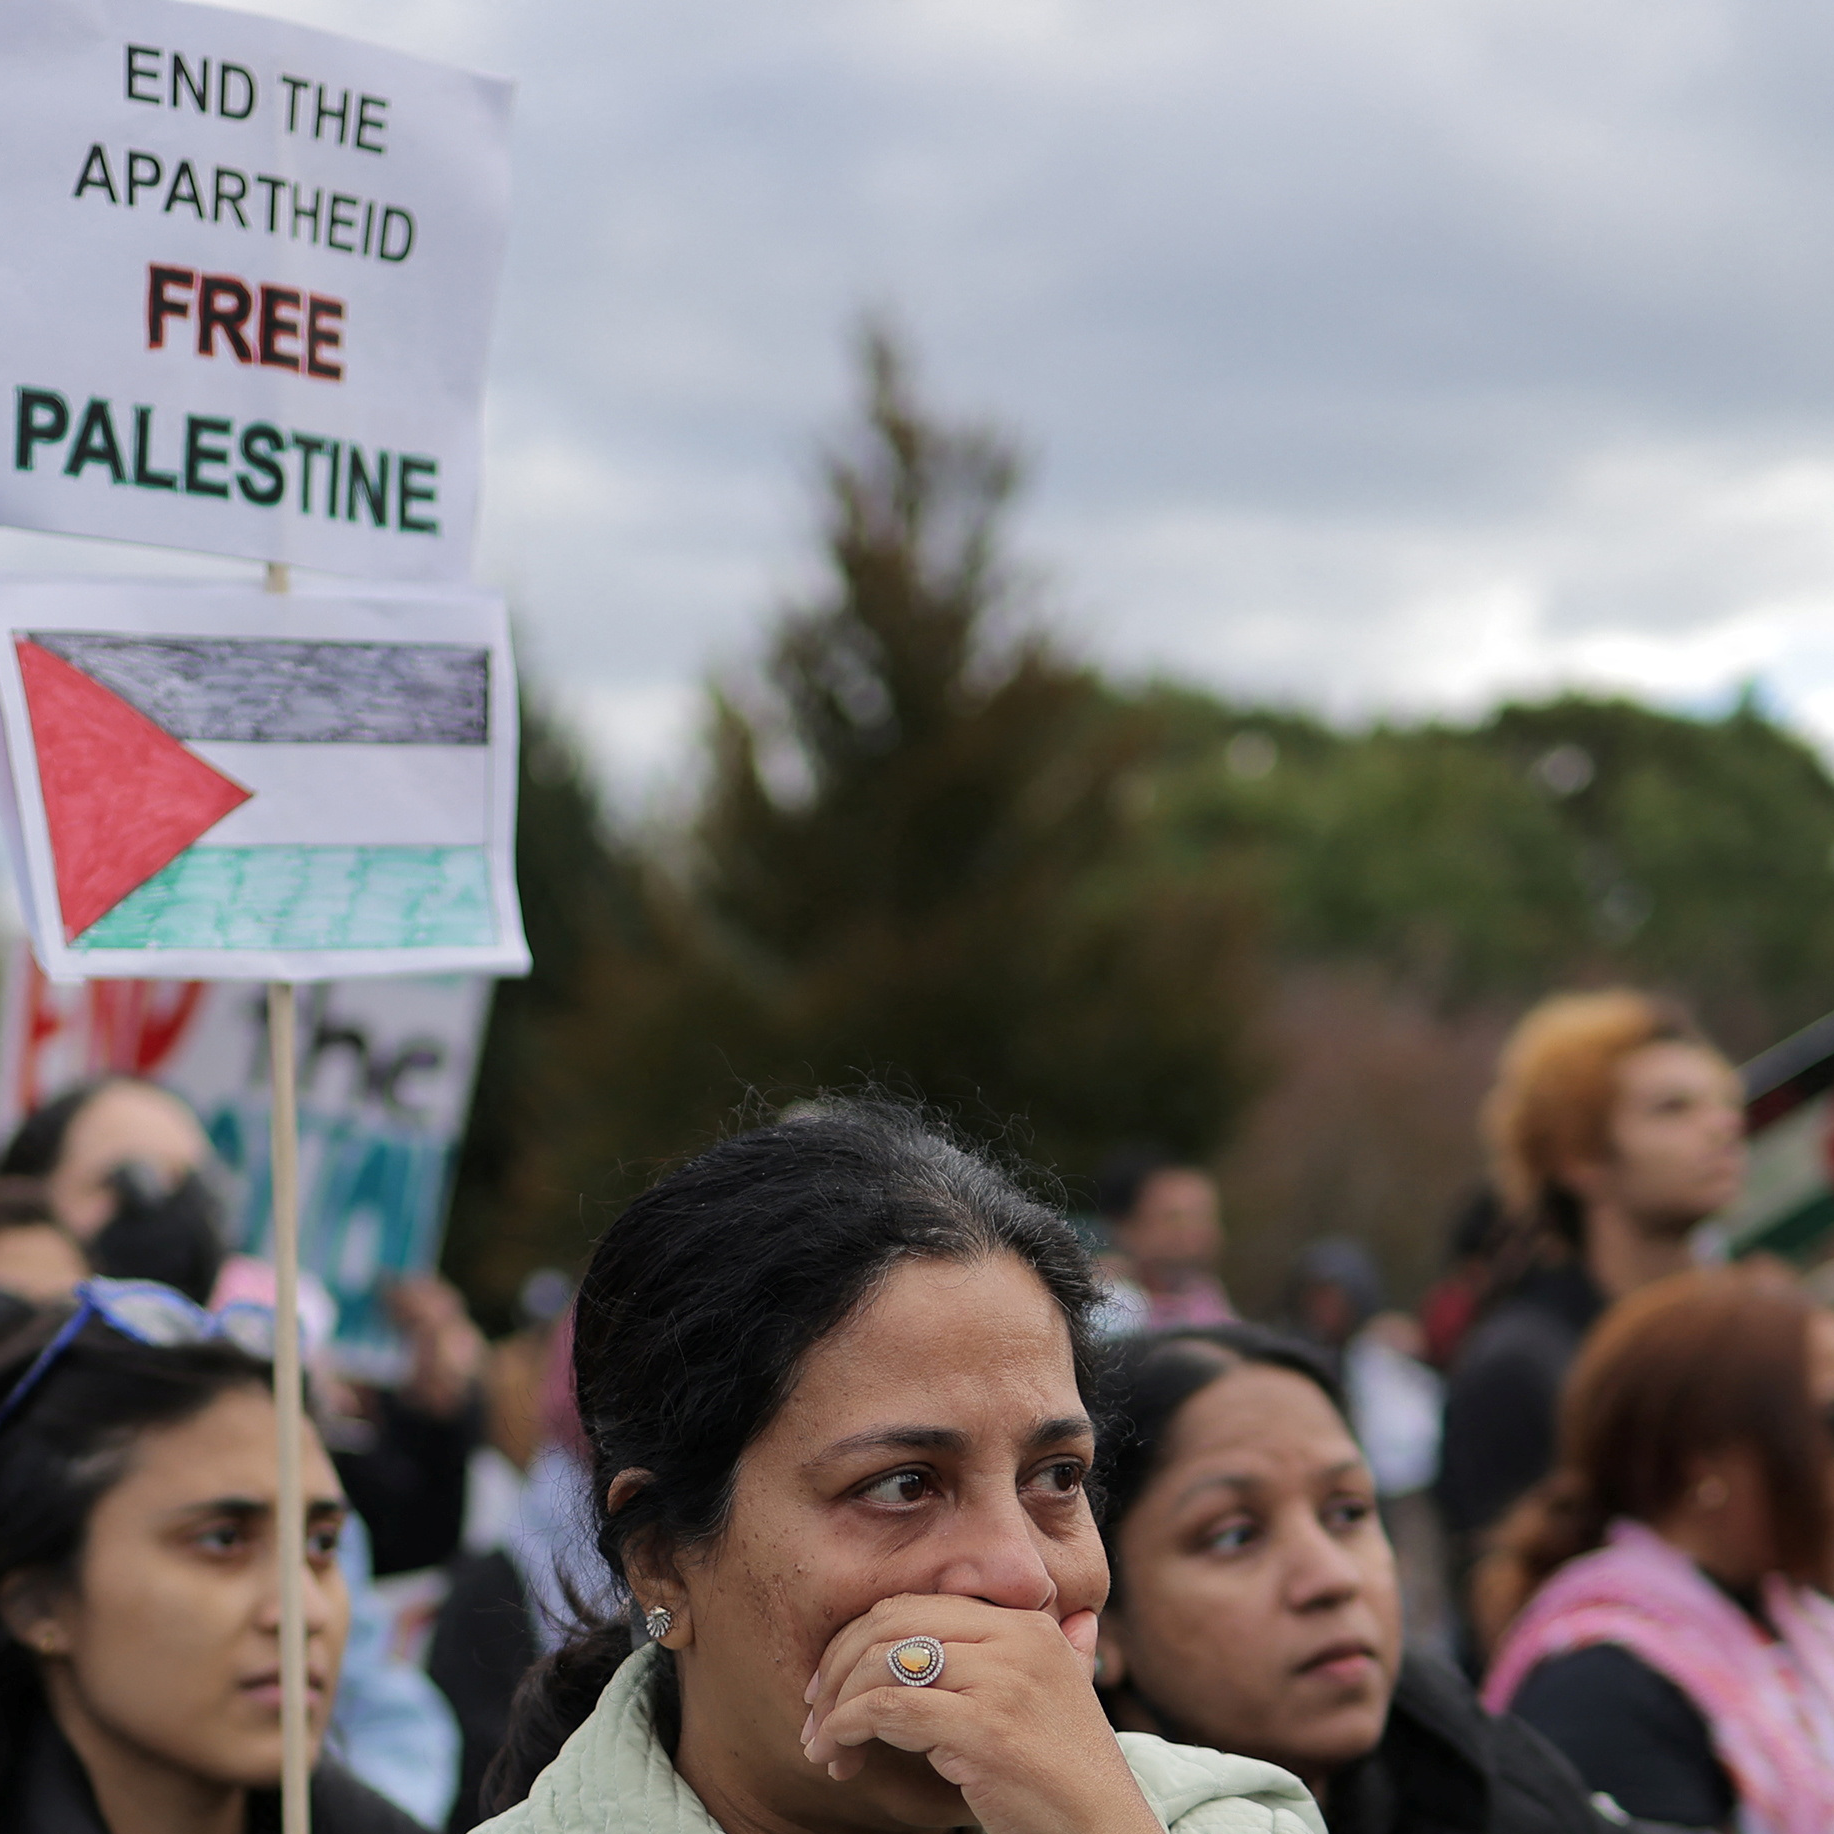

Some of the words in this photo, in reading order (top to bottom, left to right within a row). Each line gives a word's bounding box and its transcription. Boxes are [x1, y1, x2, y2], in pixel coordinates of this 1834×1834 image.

[126, 44, 256, 124] END
[280, 73, 389, 155] THE
[73, 143, 417, 265] APARTHEID
[144, 262, 348, 383] FREE
[12, 384, 441, 537] PALESTINE
